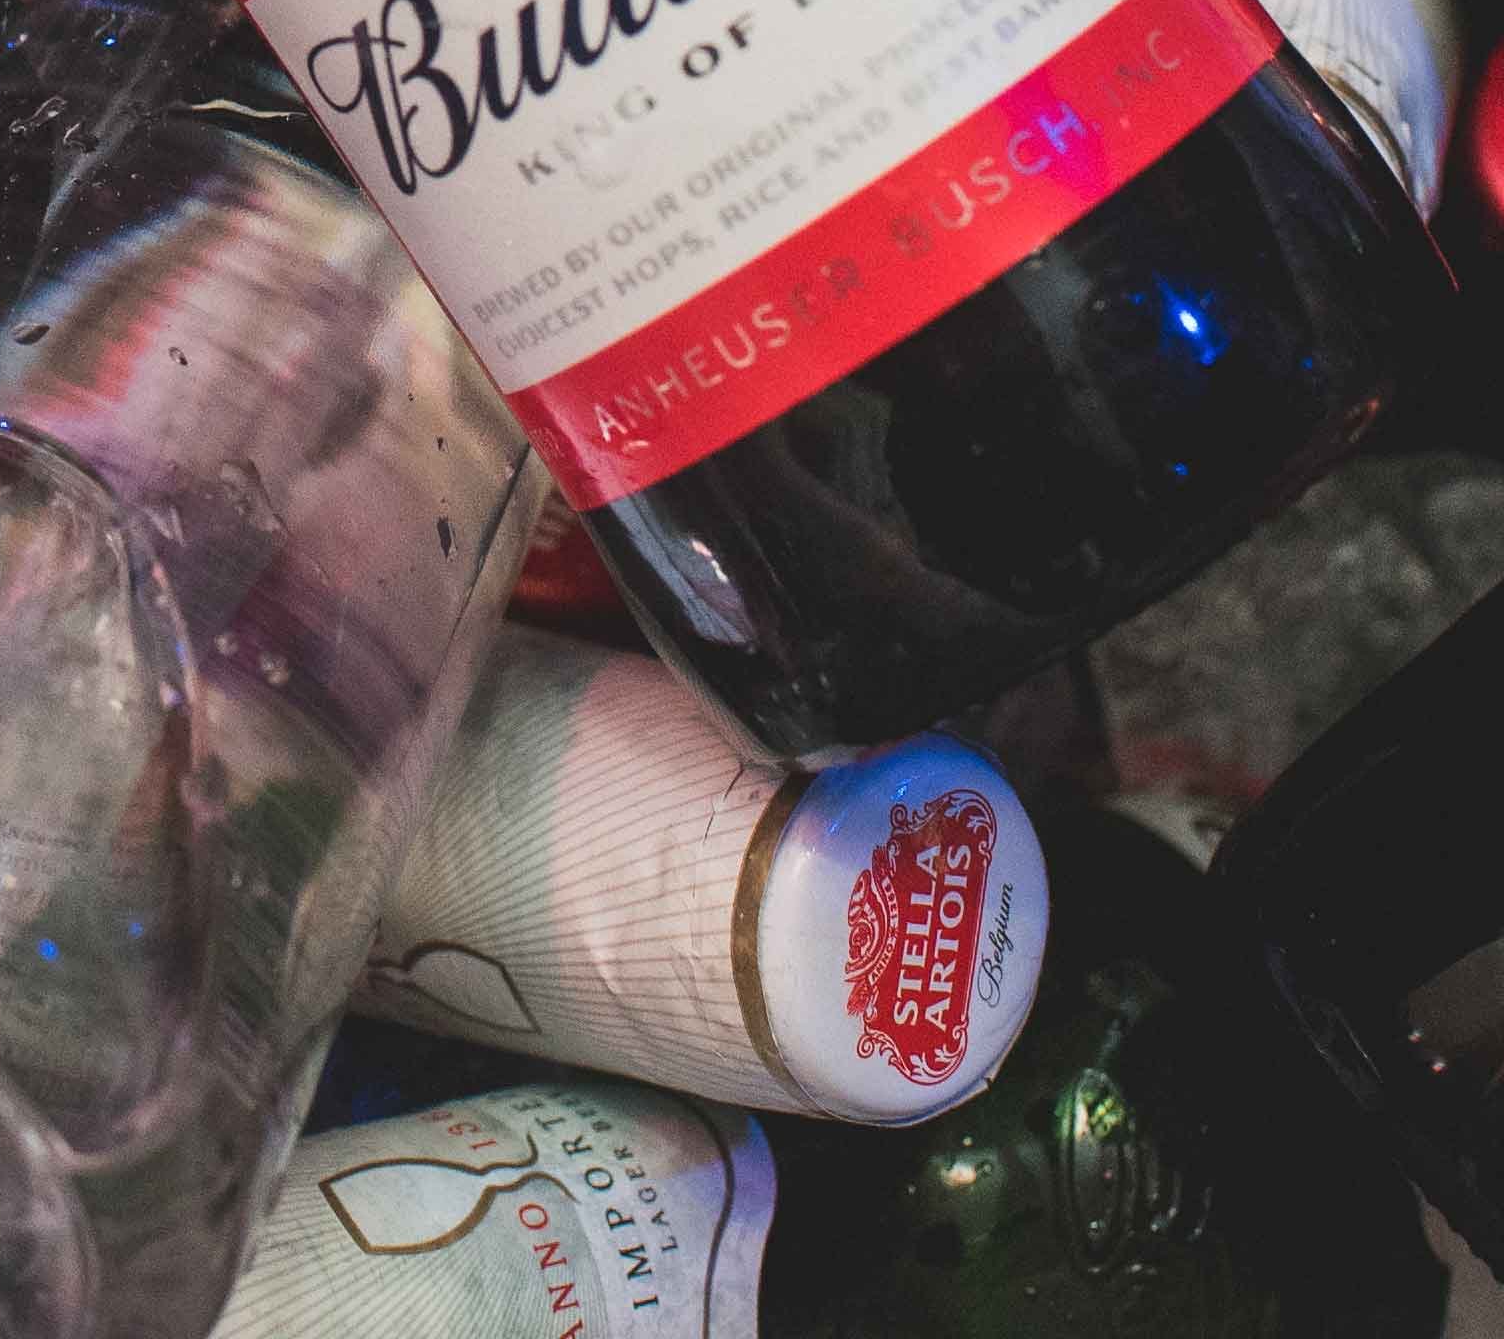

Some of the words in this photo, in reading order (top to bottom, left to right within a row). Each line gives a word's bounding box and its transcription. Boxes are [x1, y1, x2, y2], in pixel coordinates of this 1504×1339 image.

[679, 11, 757, 78] OF
[472, 264, 563, 324] BREWED
[563, 241, 604, 277] BY
[606, 191, 682, 248] OUR
[686, 73, 855, 200] ORIGINAL
[495, 284, 607, 361] CHOICEST
[611, 228, 717, 297] HOPS,
[716, 163, 809, 232] RICE
[893, 844, 943, 1027] STELLA
[925, 843, 972, 1033] ARTOIS
[976, 881, 1014, 1009] Belgium
[613, 1145, 679, 1253] LAGER
